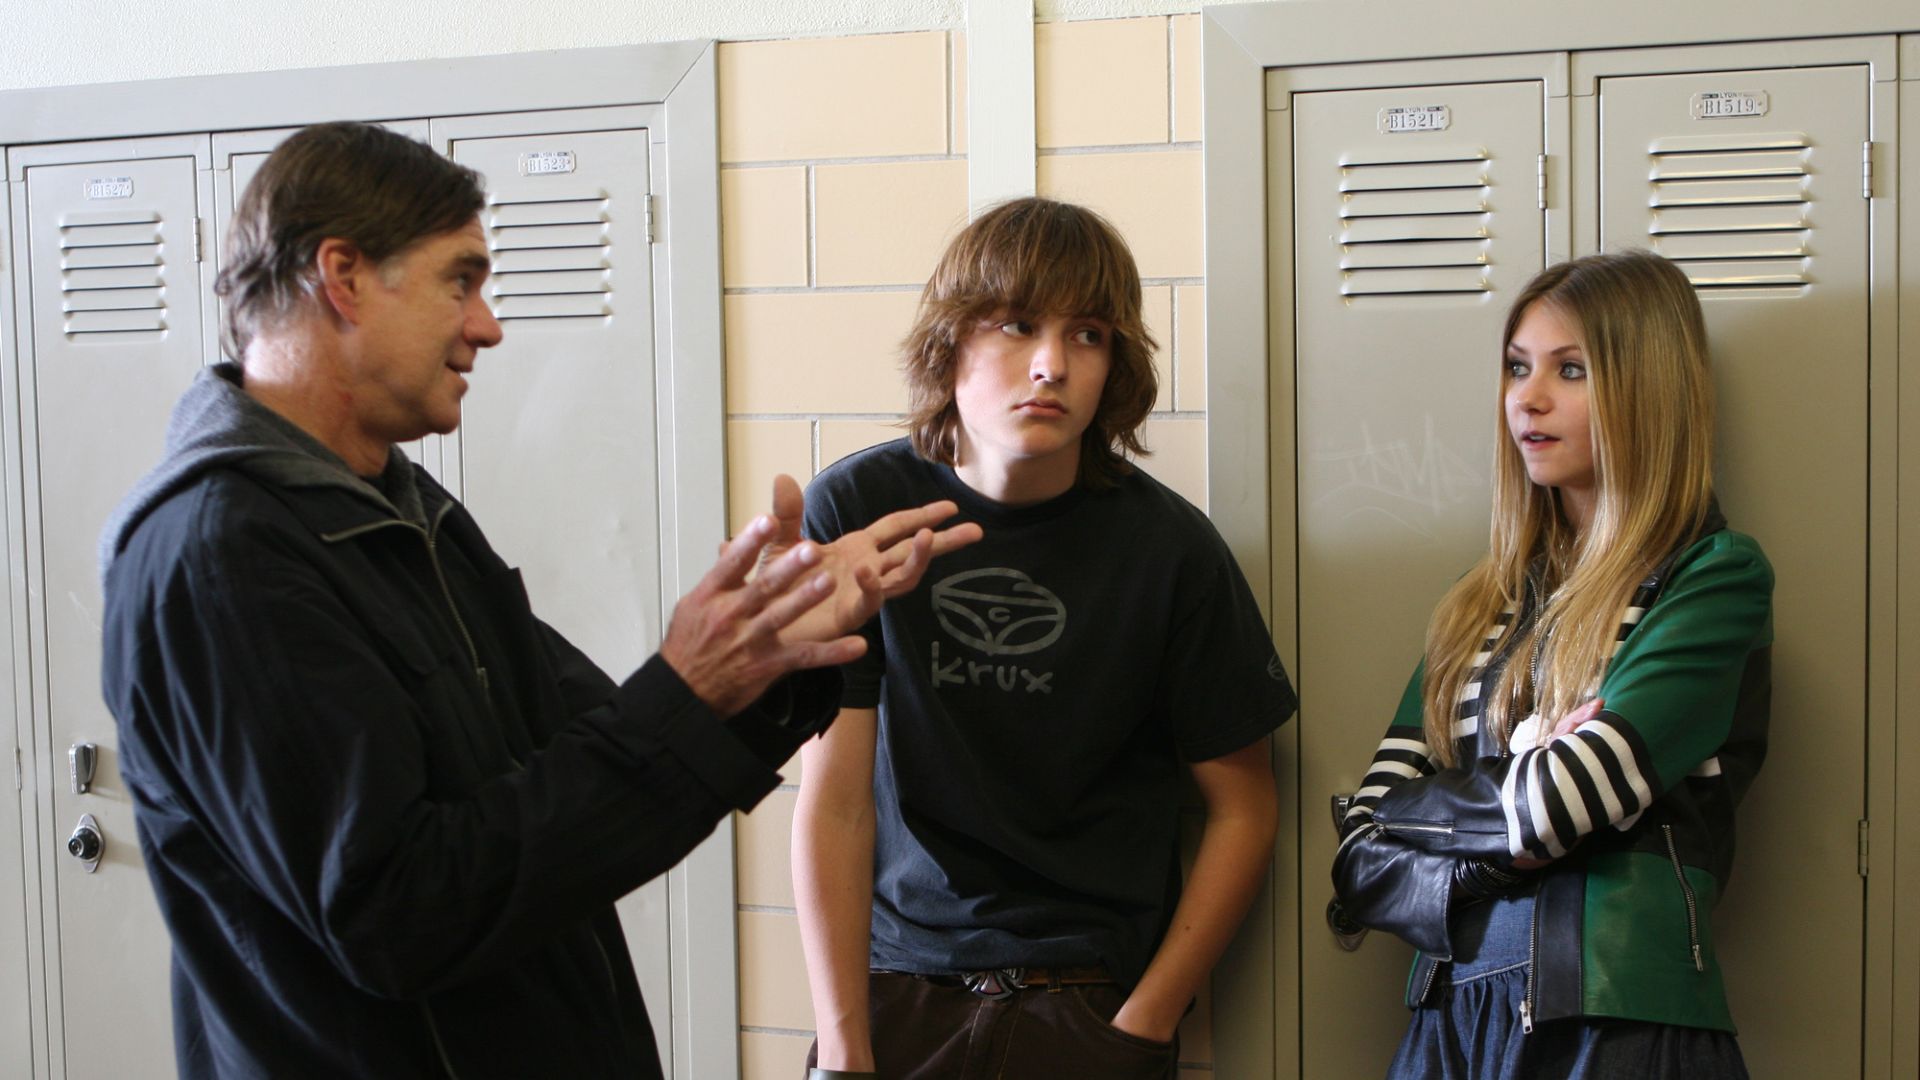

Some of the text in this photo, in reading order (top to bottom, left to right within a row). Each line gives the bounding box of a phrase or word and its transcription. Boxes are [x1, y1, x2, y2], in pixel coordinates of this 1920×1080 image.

[1705, 98, 1754, 114] B1519
[1390, 113, 1433, 129] B1521
[529, 158, 566, 171] B1523
[93, 183, 125, 196] B1527
[931, 641, 1053, 694] krux
